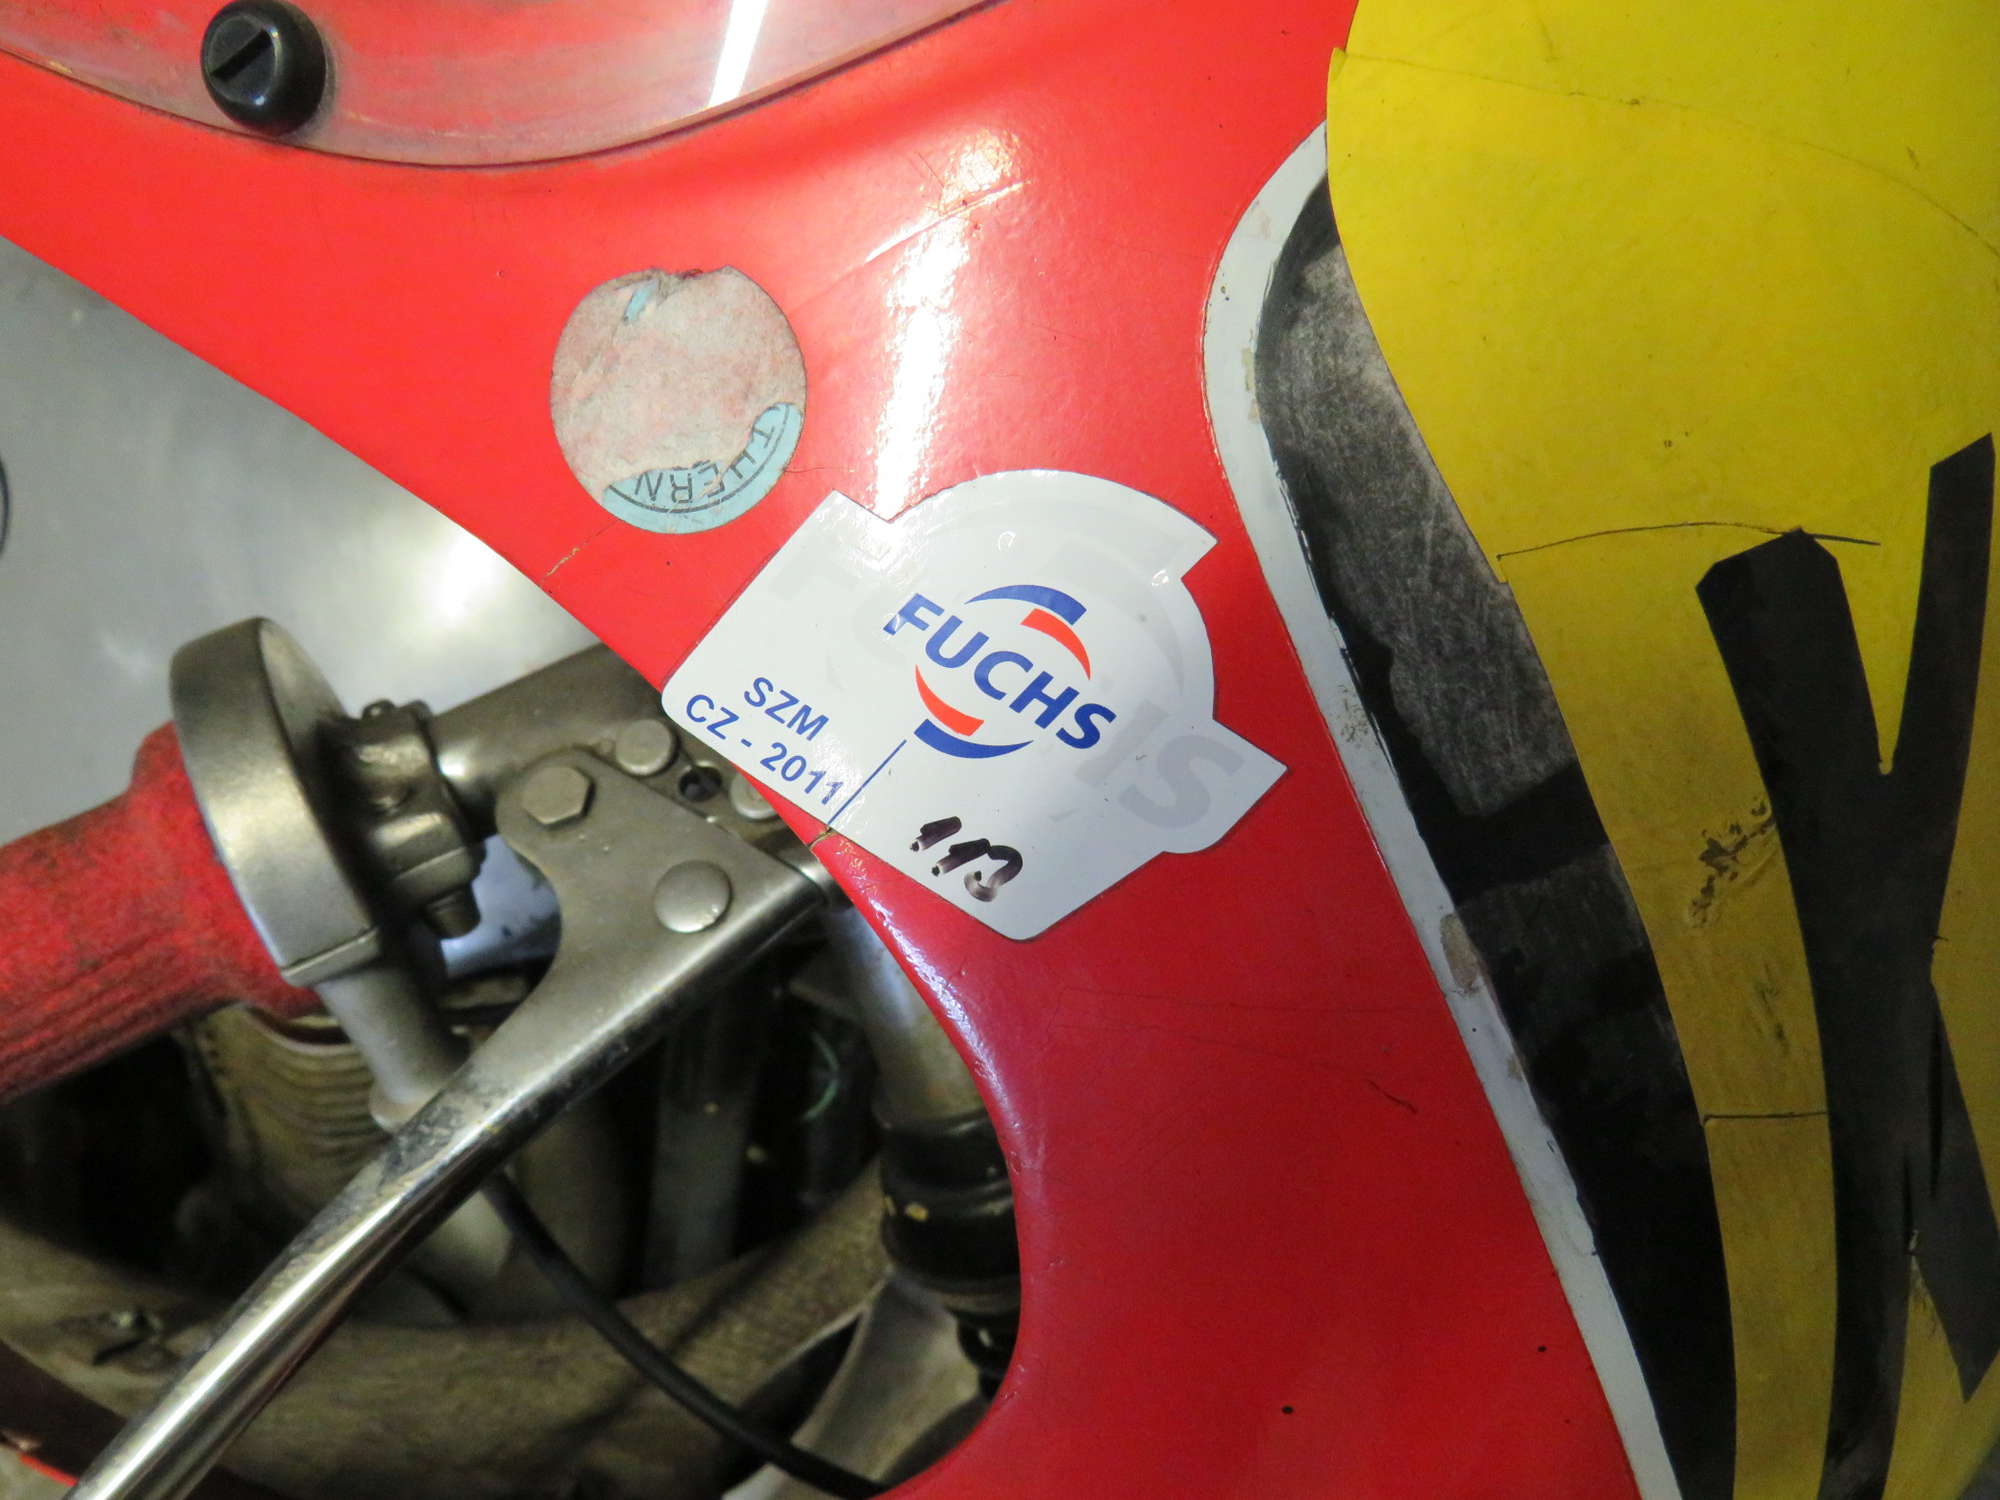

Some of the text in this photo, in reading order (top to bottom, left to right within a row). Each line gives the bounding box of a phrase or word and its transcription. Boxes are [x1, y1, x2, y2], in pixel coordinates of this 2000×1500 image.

[634, 404, 783, 504] THERN
[743, 677, 829, 741] SZM
[883, 593, 1117, 750] FUCHS
[686, 694, 740, 740] CZ
[760, 742, 844, 805] 2011
